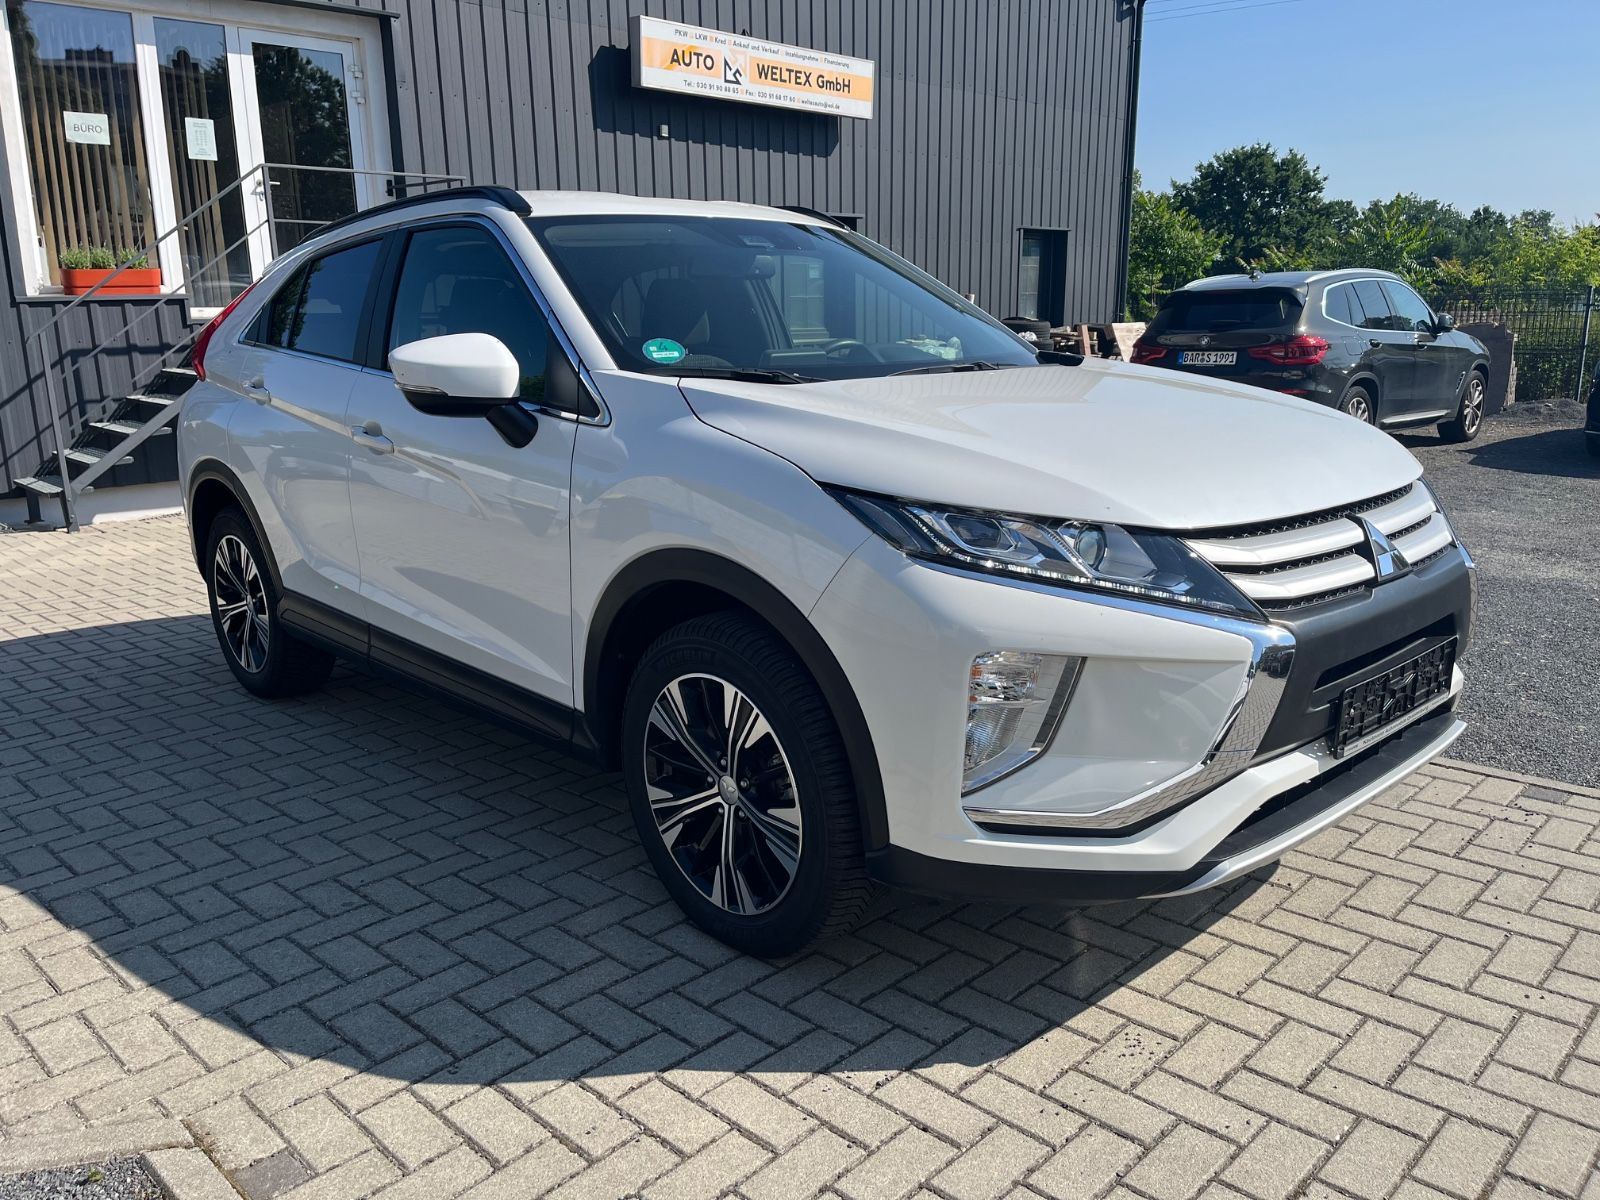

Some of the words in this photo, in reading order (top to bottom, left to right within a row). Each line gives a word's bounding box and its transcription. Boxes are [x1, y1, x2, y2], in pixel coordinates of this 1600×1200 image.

[675, 29, 688, 38] PKW
[695, 32, 708, 41] LKW
[733, 40, 750, 49] Ankauf
[761, 45, 780, 55] Verkauf
[824, 57, 850, 69] Finanzierung
[670, 48, 715, 71] AUTO
[756, 63, 812, 88] WELTEX
[816, 74, 851, 94] GmbH
[758, 91, 767, 99] 030
[73, 122, 103, 134] BÜRO
[1184, 352, 1200, 363] BAR
[1206, 352, 1212, 363] S
[1213, 352, 1235, 363] 1991
